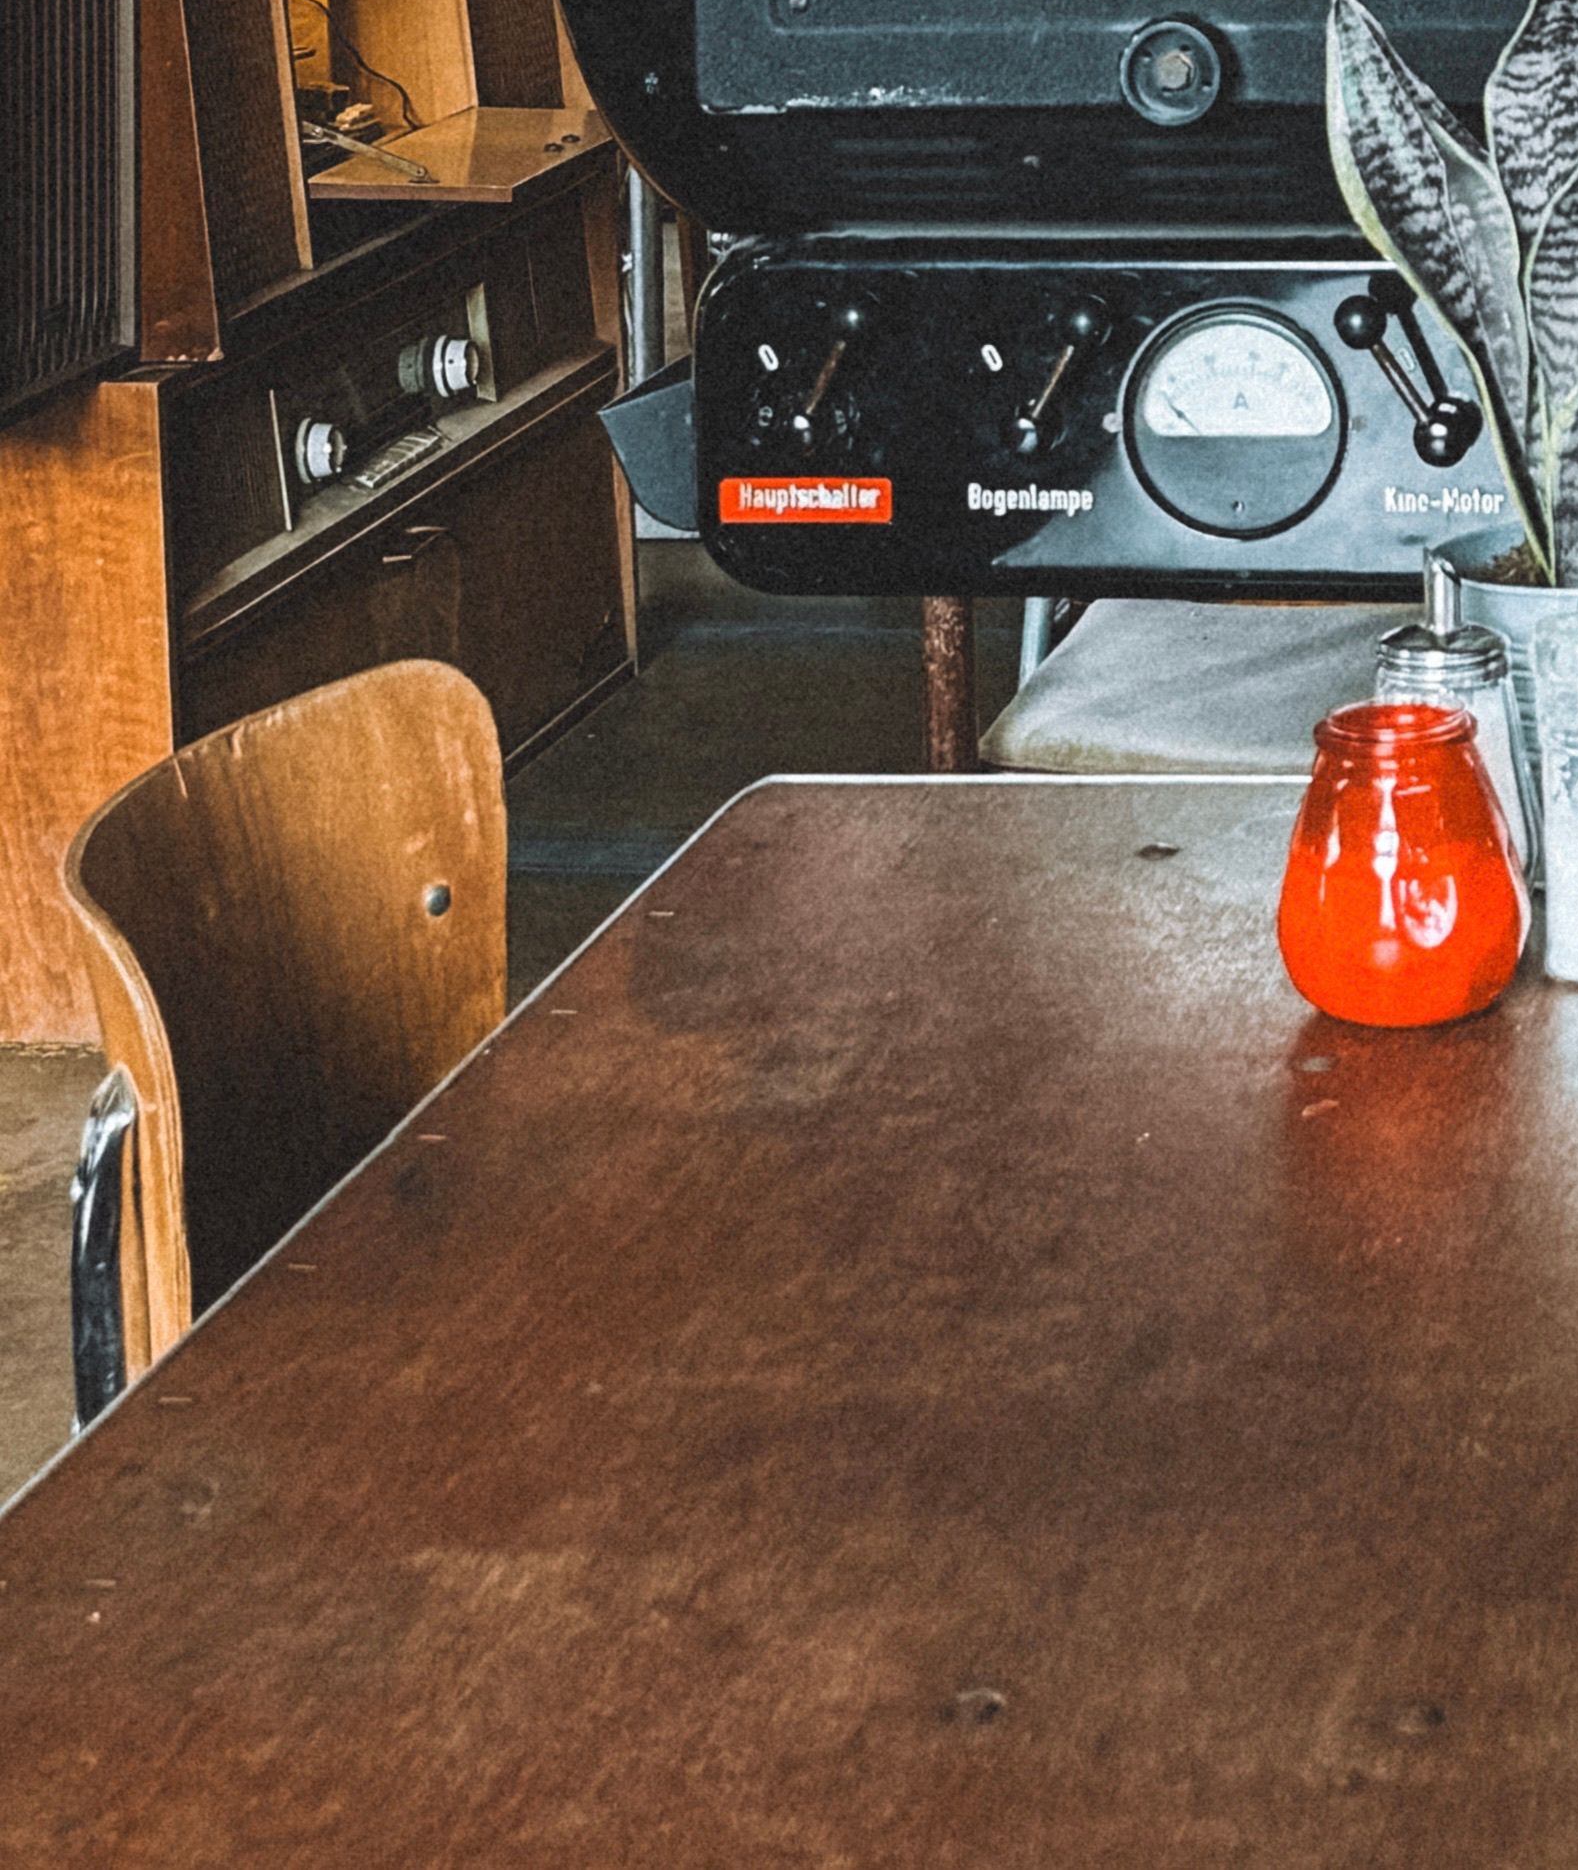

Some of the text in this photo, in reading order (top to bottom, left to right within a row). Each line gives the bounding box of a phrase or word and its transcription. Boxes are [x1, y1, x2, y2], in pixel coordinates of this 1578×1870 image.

[1232, 391, 1250, 411] A
[738, 483, 881, 515] Hauptschalter
[967, 482, 1094, 517] Bogenlampe
